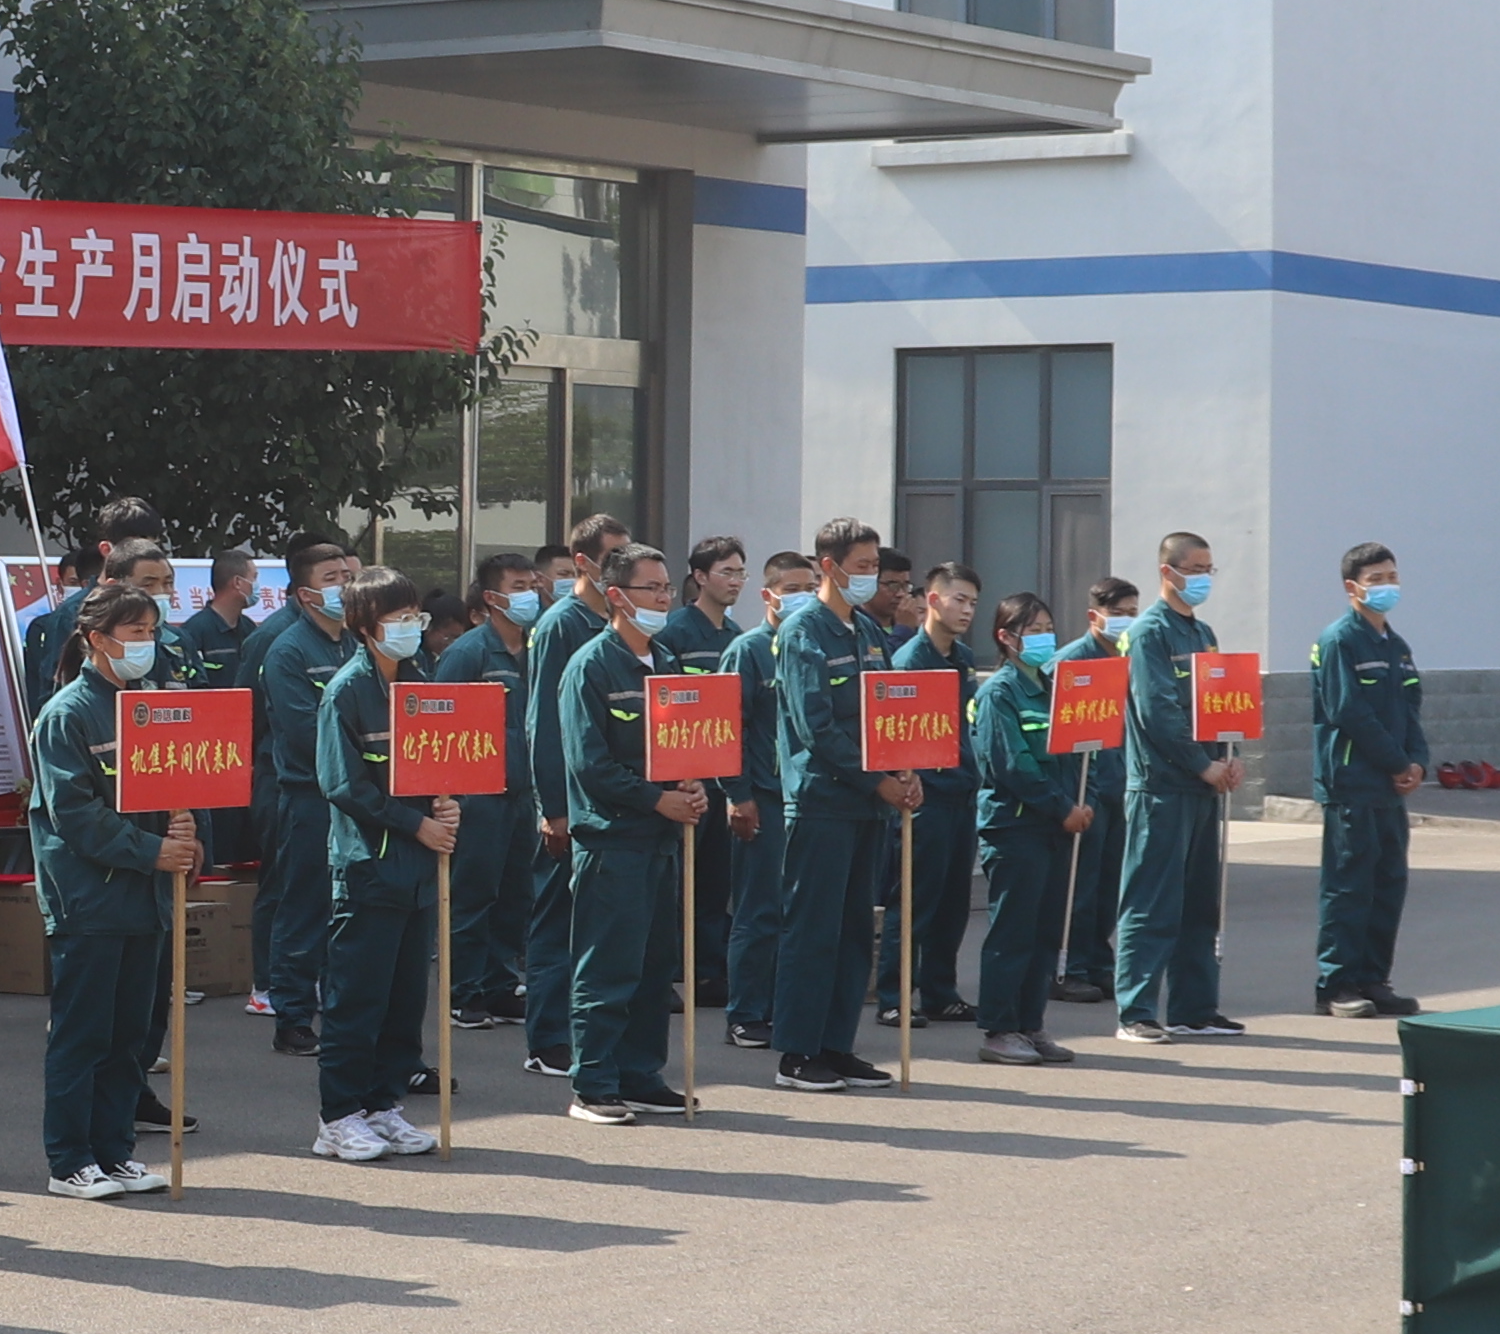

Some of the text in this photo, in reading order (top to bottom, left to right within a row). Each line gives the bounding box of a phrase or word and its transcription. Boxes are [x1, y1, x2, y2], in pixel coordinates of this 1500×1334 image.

[130, 739, 242, 775] 机焦车间代表队
[402, 729, 497, 763] 化产分厂代表队
